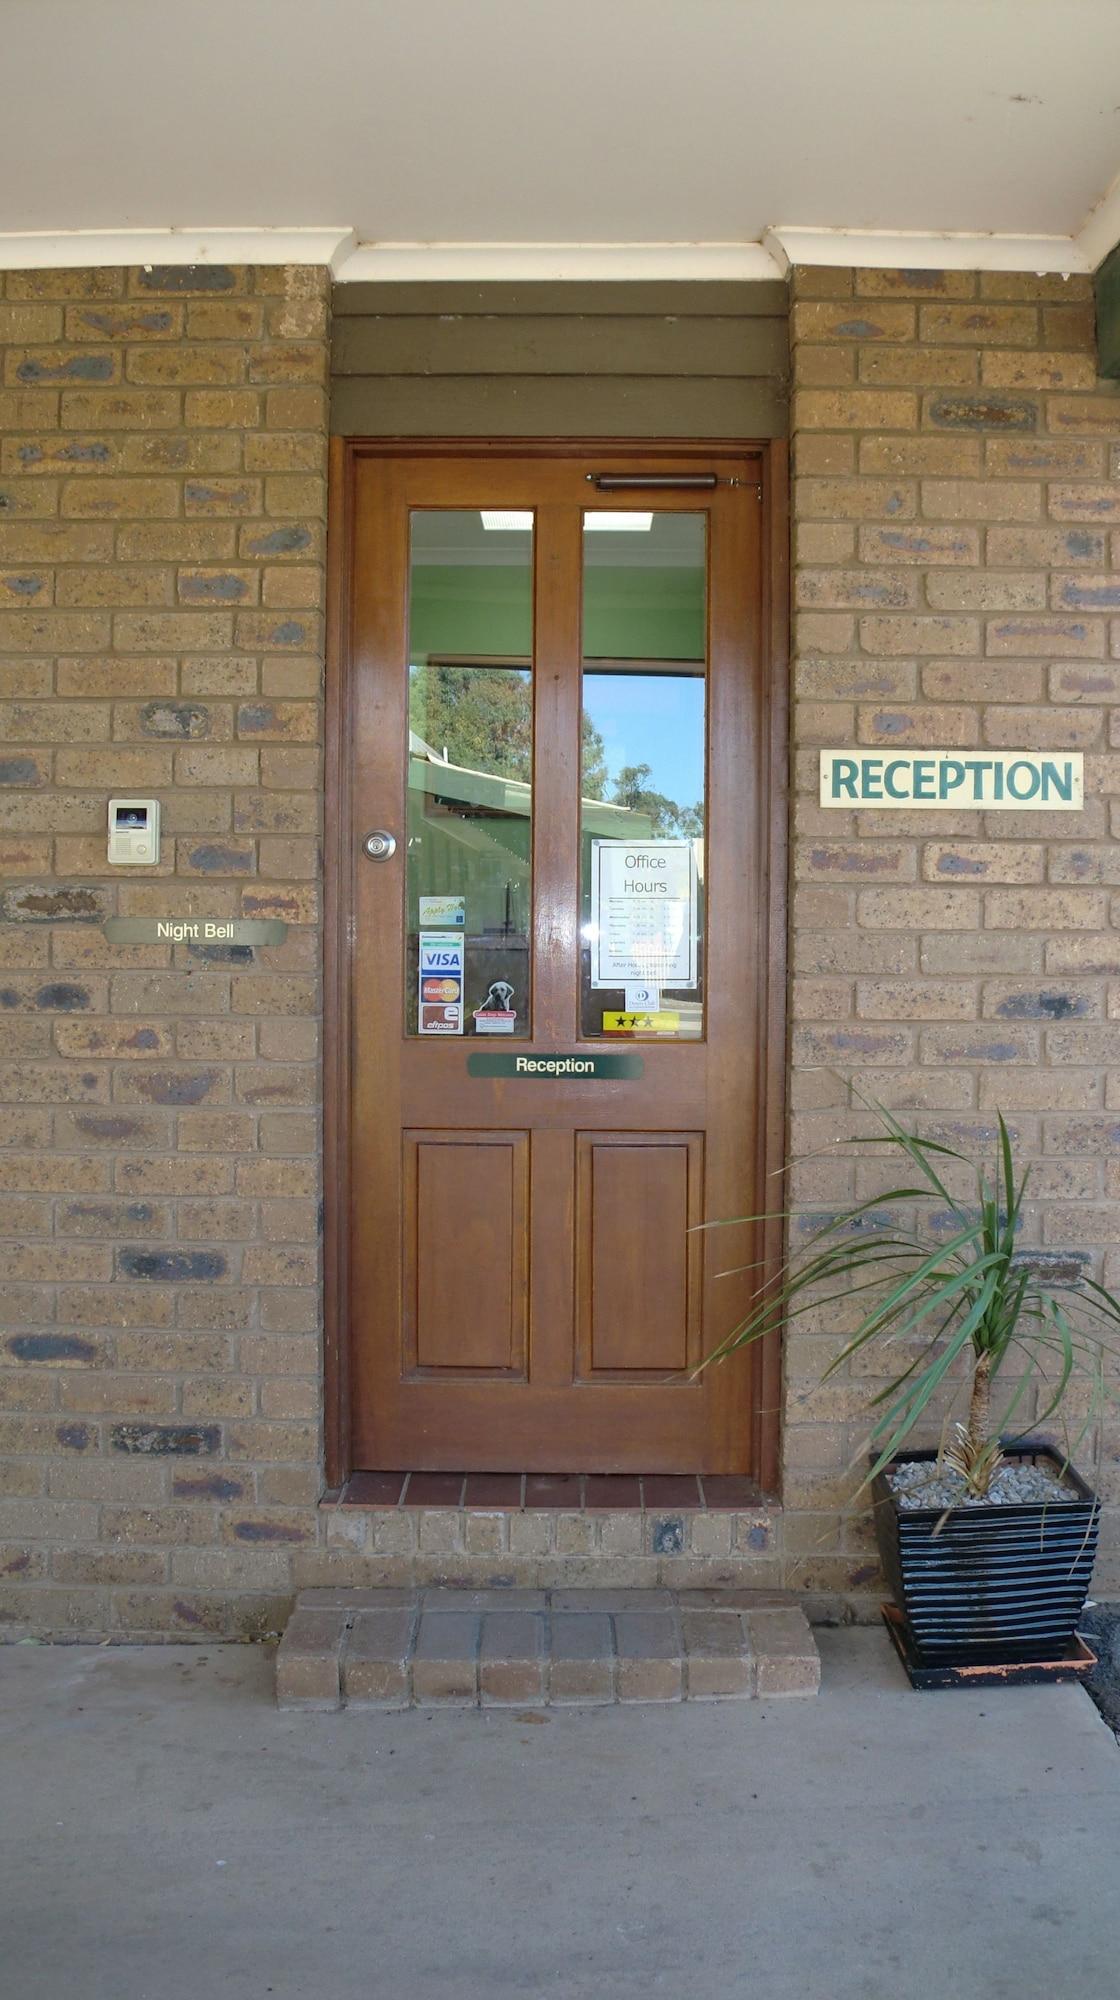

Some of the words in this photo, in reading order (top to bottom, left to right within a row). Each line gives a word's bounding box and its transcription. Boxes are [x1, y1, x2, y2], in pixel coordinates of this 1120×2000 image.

[831, 759, 1073, 800] RECEPTION
[624, 854, 667, 869] Office
[623, 879, 668, 893] Hours
[157, 922, 199, 941] Night
[204, 923, 234, 938] Bell
[425, 953, 460, 966] VISA
[426, 1020, 455, 1031] eftpos
[516, 1057, 595, 1076] Reception
